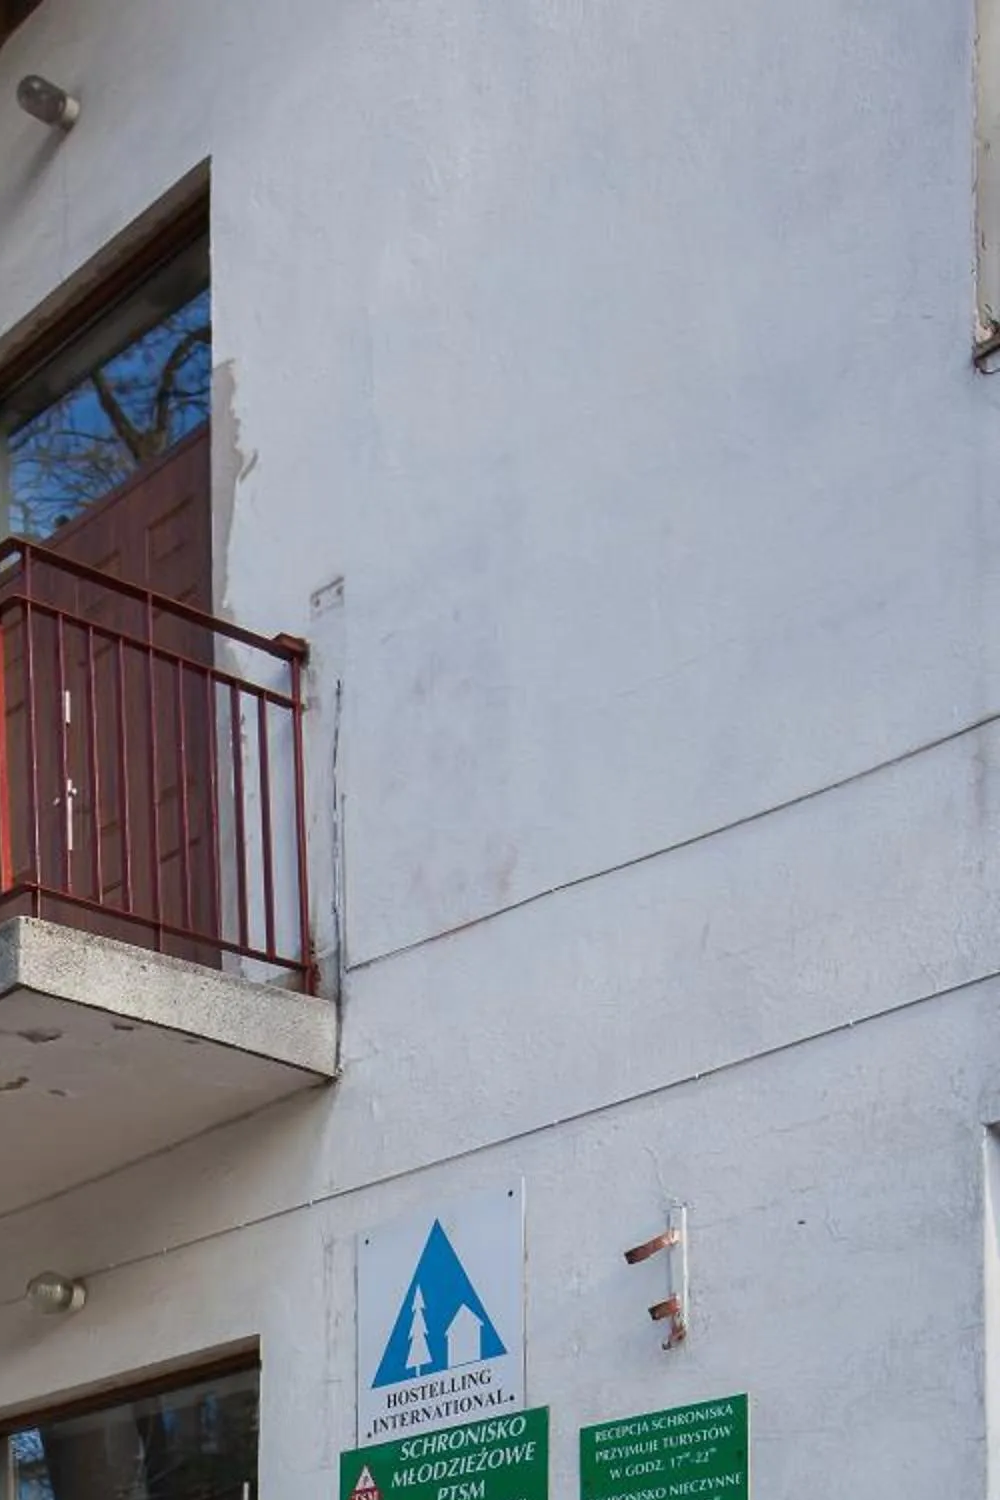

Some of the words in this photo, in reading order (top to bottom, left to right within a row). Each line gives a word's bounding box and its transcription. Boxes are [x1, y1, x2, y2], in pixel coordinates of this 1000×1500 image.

[387, 1369, 491, 1409] HOSTELLING
[373, 1389, 507, 1434] INTERNATIONAL
[595, 1420, 649, 1443] RECEPCJA
[651, 1404, 734, 1431] SCHRONISKA
[400, 1416, 526, 1461] SCHRONISKO
[595, 1439, 658, 1464] PRZYJMUJE
[663, 1424, 732, 1448] TURYSTÓW
[391, 1442, 536, 1488] MŁODZIEŻOWE
[610, 1467, 622, 1480] W
[625, 1459, 665, 1477] GODZ.
[669, 1472, 743, 1496] NIECZYNNE
